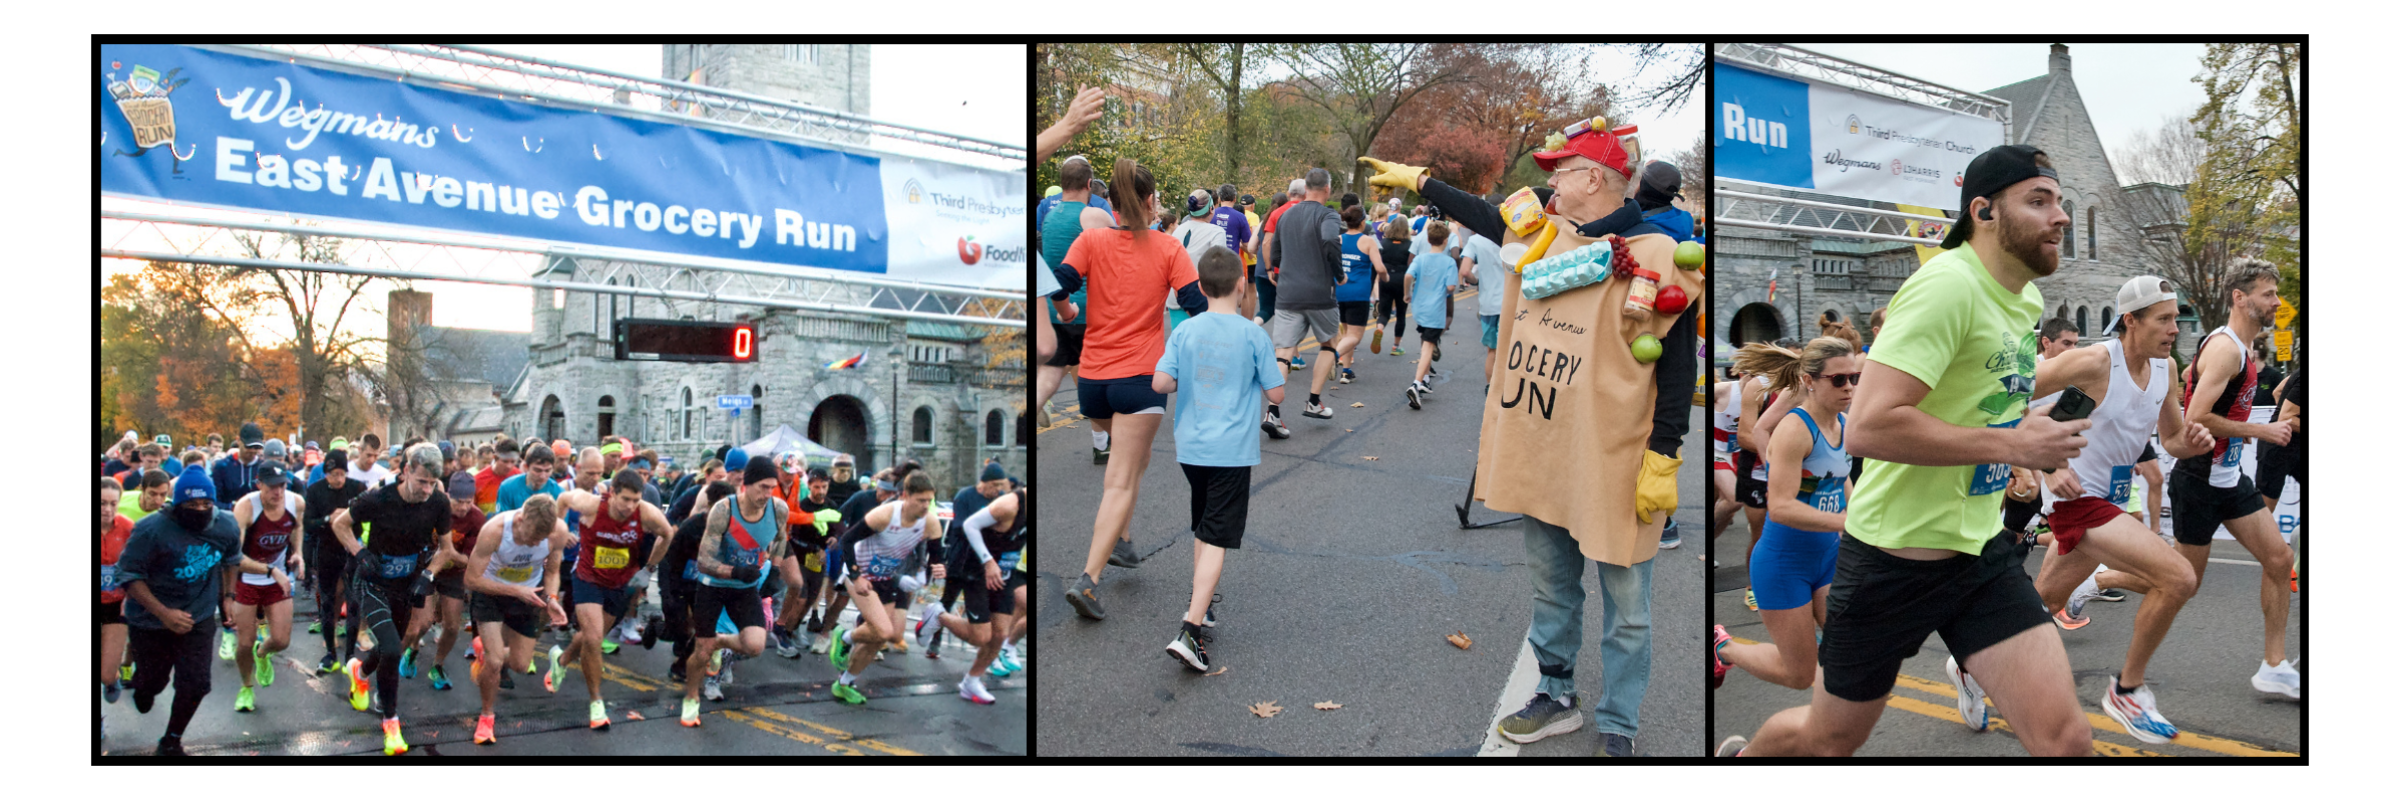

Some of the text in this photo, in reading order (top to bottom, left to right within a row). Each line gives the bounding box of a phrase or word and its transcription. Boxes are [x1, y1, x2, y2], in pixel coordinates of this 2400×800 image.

[223, 77, 439, 151] Wegmans
[1722, 102, 1788, 149] Run
[137, 126, 173, 144] RUN
[1865, 125, 1890, 140] Third
[1945, 140, 1977, 155] Church
[1823, 149, 1881, 173] Wegmans
[215, 136, 857, 252] East Avenue Grocery Run
[930, 192, 965, 210] Third
[1539, 308, 1587, 334] Avenue
[735, 328, 751, 358] 0
[1508, 341, 1582, 385] OCERY
[1501, 377, 1556, 420] UN
[1818, 495, 1840, 513] 668
[258, 534, 289, 546] GVH
[385, 563, 411, 575] 291
